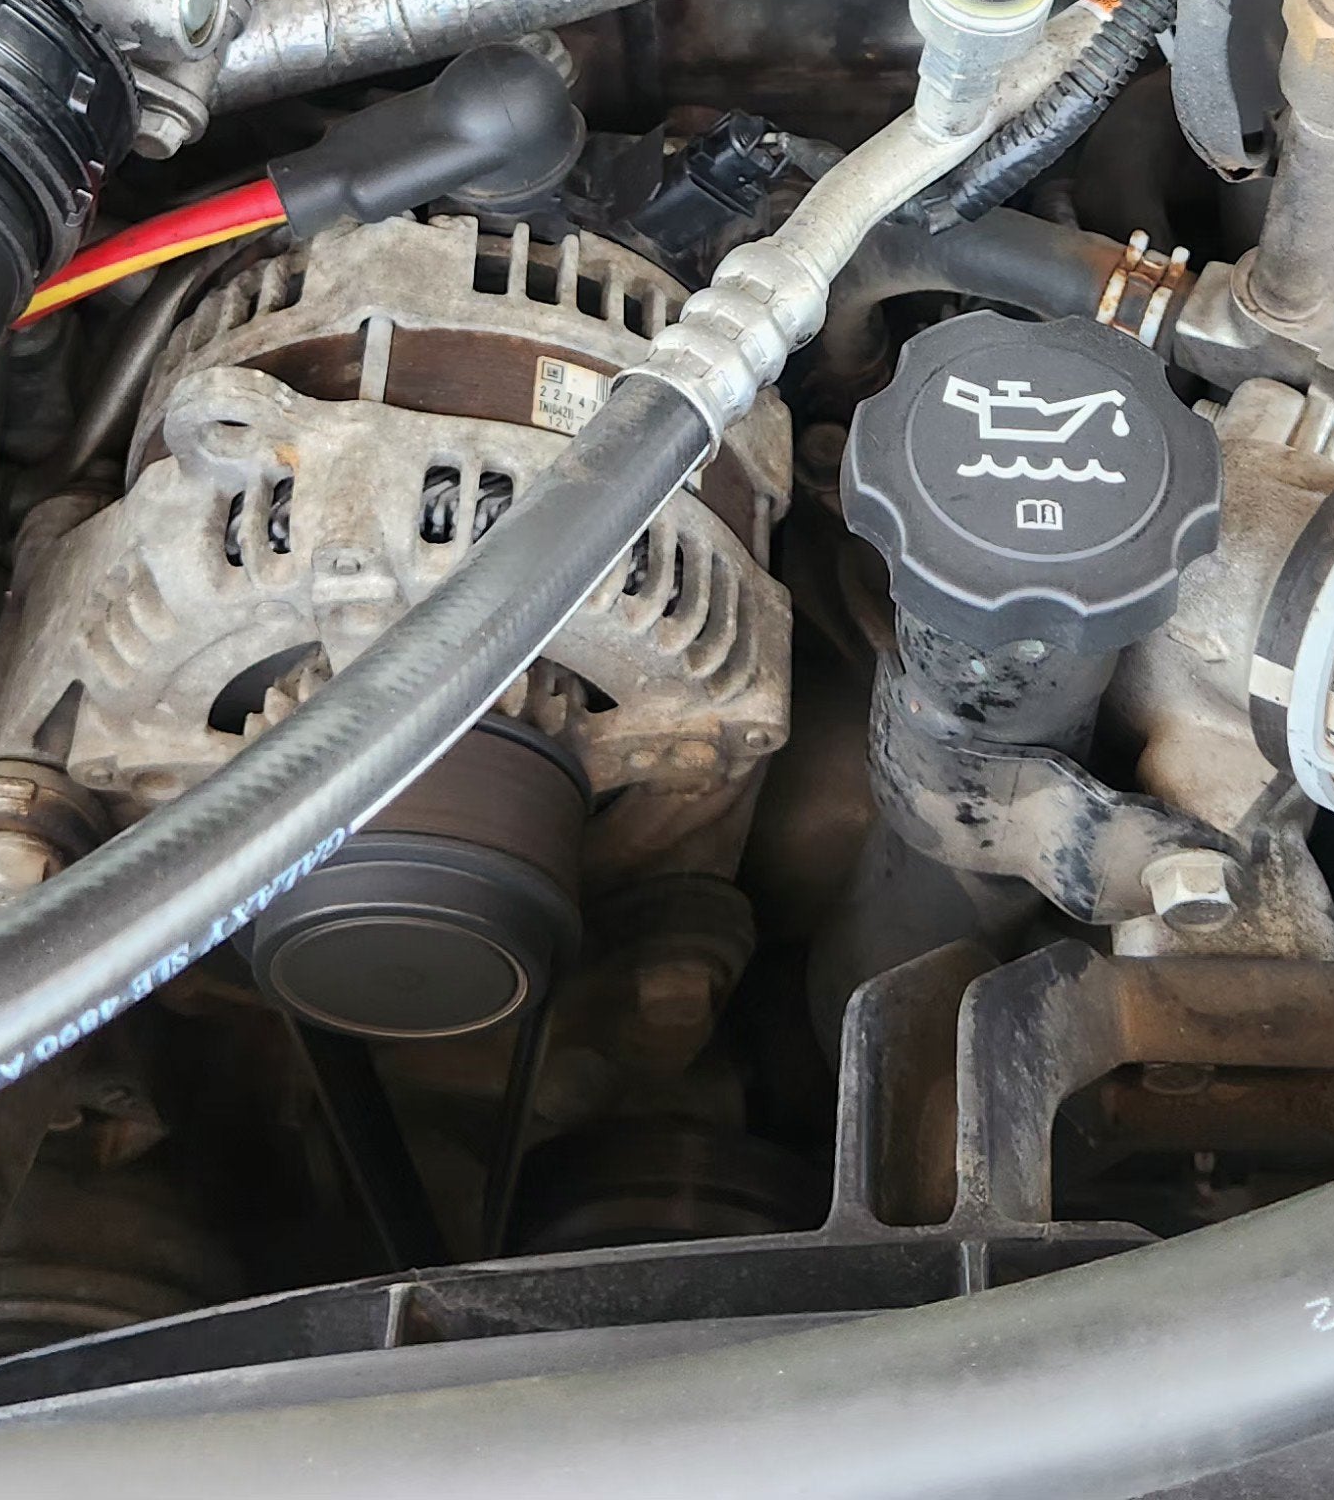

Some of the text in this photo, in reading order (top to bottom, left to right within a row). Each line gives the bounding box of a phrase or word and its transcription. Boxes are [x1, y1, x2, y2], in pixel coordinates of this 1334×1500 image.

[539, 385, 598, 413] 22747
[200, 826, 347, 953] GALAXY
[130, 943, 191, 999] SLE
[34, 994, 121, 1062] 4890
